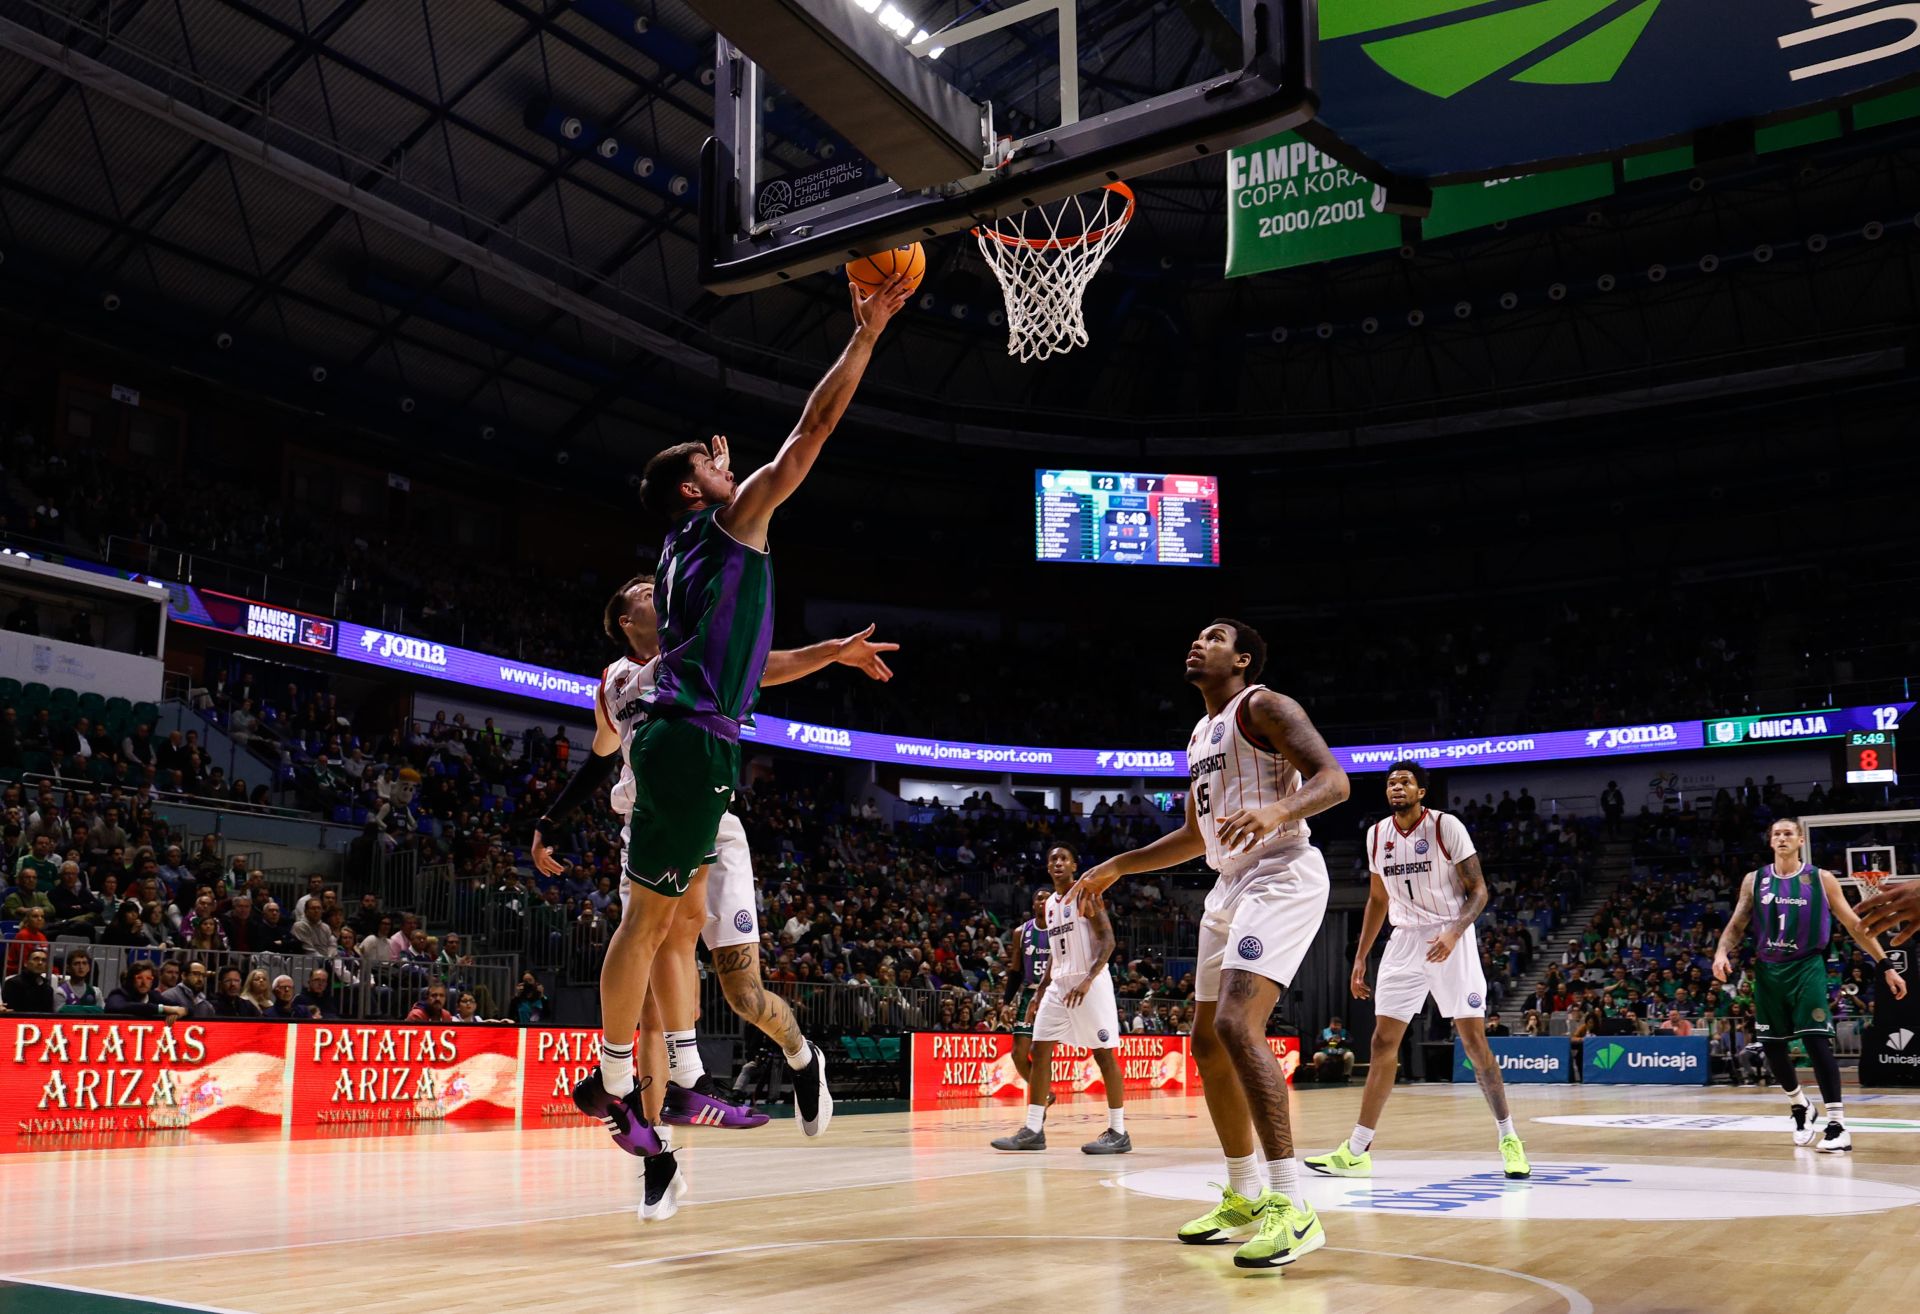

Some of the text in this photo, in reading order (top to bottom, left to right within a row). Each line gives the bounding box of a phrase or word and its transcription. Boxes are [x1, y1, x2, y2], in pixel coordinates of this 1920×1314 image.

[794, 162, 855, 187] BASKETBALL
[794, 167, 863, 198] CHAMPIONS
[794, 189, 831, 207] LEAGUE
[1238, 180, 1299, 209] COPA
[1259, 198, 1365, 238] 2000/2001
[1098, 477, 1114, 490] 12
[1146, 479, 1156, 491] 7
[1116, 511, 1147, 525] 5:49
[248, 604, 296, 630] MANISA
[246, 620, 296, 644] BASKET
[1749, 707, 1900, 739] UNICAJA 12
[1351, 738, 1535, 763] www.joma-sport.com
[1852, 733, 1886, 745] 5:49
[895, 741, 1053, 763] www.joma-sport.com
[1859, 749, 1879, 771] 8
[1406, 860, 1432, 874] BASKET
[1404, 879, 1414, 900] 1
[1775, 897, 1808, 907] Unicaja
[1778, 913, 1786, 931] 1
[13, 1023, 206, 1063] PATATAS
[313, 1028, 457, 1062] PATATAS
[537, 1031, 601, 1062] PATA
[666, 1040, 678, 1069] UNICAJA
[933, 1035, 998, 1059] PATATAS
[1117, 1037, 1164, 1057] PATATAS
[942, 1061, 989, 1086] ARIZA
[1124, 1060, 1158, 1080] ARIZA
[1627, 1052, 1697, 1072] Unicaja
[37, 1068, 178, 1111] ARIZA
[331, 1067, 435, 1103] ARIZA
